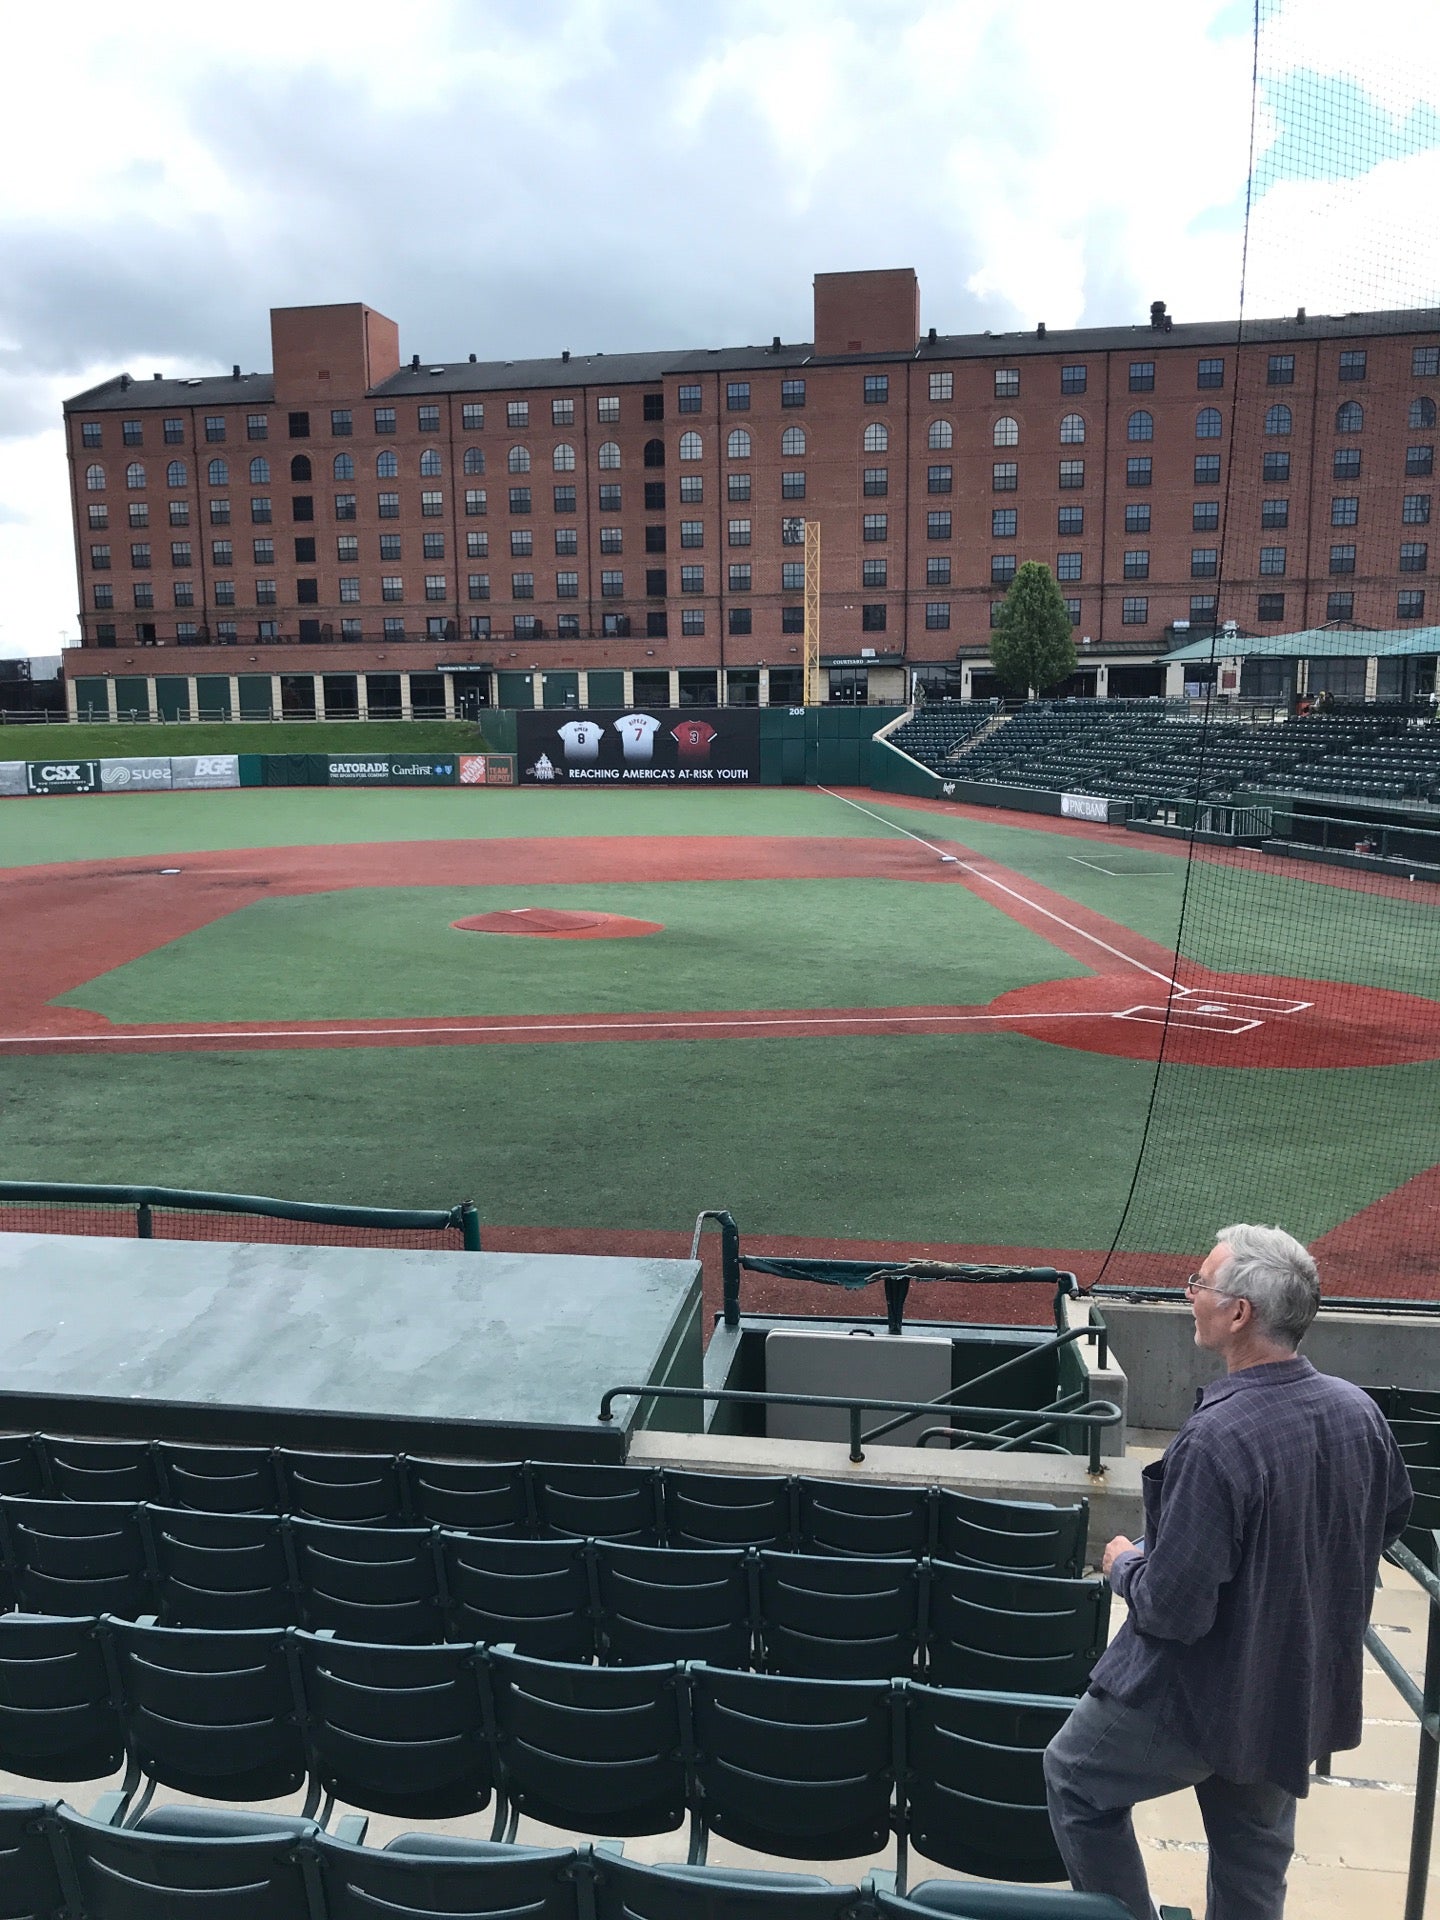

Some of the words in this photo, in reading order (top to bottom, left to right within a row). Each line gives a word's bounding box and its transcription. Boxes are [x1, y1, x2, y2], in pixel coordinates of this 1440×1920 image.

[789, 708, 805, 716] 205
[577, 733, 585, 745] 8
[634, 728, 643, 742] 7
[690, 730, 699, 745] 3
[41, 765, 81, 781] CSX
[194, 758, 235, 776] BGE
[329, 762, 389, 773] GATORADE
[460, 754, 486, 783] HOME
[569, 769, 620, 779] REACHING
[622, 769, 676, 779] AMERICA'S
[678, 769, 713, 779] AT-RISK
[716, 769, 749, 779] YOUTH
